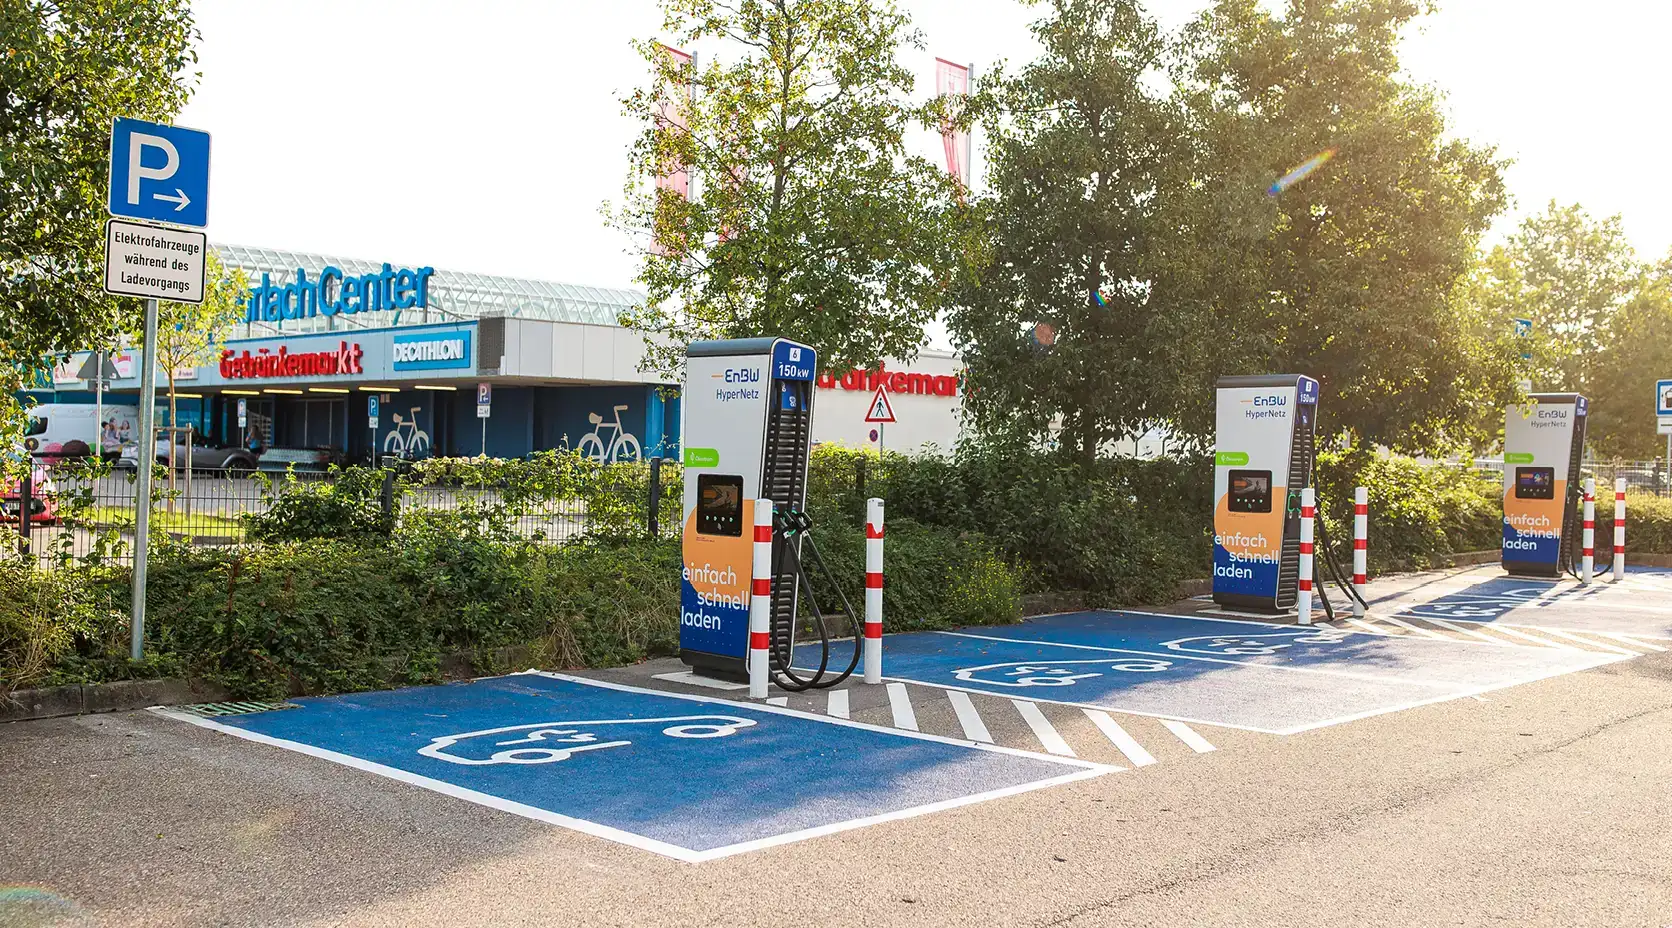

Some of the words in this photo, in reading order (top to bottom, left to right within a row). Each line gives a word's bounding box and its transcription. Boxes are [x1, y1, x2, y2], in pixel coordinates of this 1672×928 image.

[127, 131, 180, 205] P
[114, 231, 200, 256] Elektrofahrzeuge
[124, 252, 168, 269] während
[171, 256, 189, 272] des
[120, 271, 190, 293] Ladevorgangs
[393, 338, 464, 363] DECATHLON
[792, 349, 798, 359] 6
[219, 340, 364, 379] Getränkemarkt
[724, 368, 760, 383] EnBW
[778, 363, 797, 377] 150
[480, 385, 487, 402] P
[716, 388, 759, 402] HyperNetz
[1253, 395, 1287, 407] EnBW
[370, 399, 376, 414] P
[1245, 409, 1286, 420] HyperNetz
[1538, 410, 1567, 419] EnBW
[1530, 420, 1567, 429] HyperNetz
[1503, 513, 1550, 526] einfach
[1214, 531, 1267, 548] einfach
[1516, 526, 1560, 539] schnell
[1502, 536, 1537, 550] laden
[1229, 548, 1279, 565] schnell
[682, 562, 737, 585] einfach
[1213, 561, 1253, 579] laden
[697, 588, 749, 611] schnell
[680, 605, 721, 631] laden
